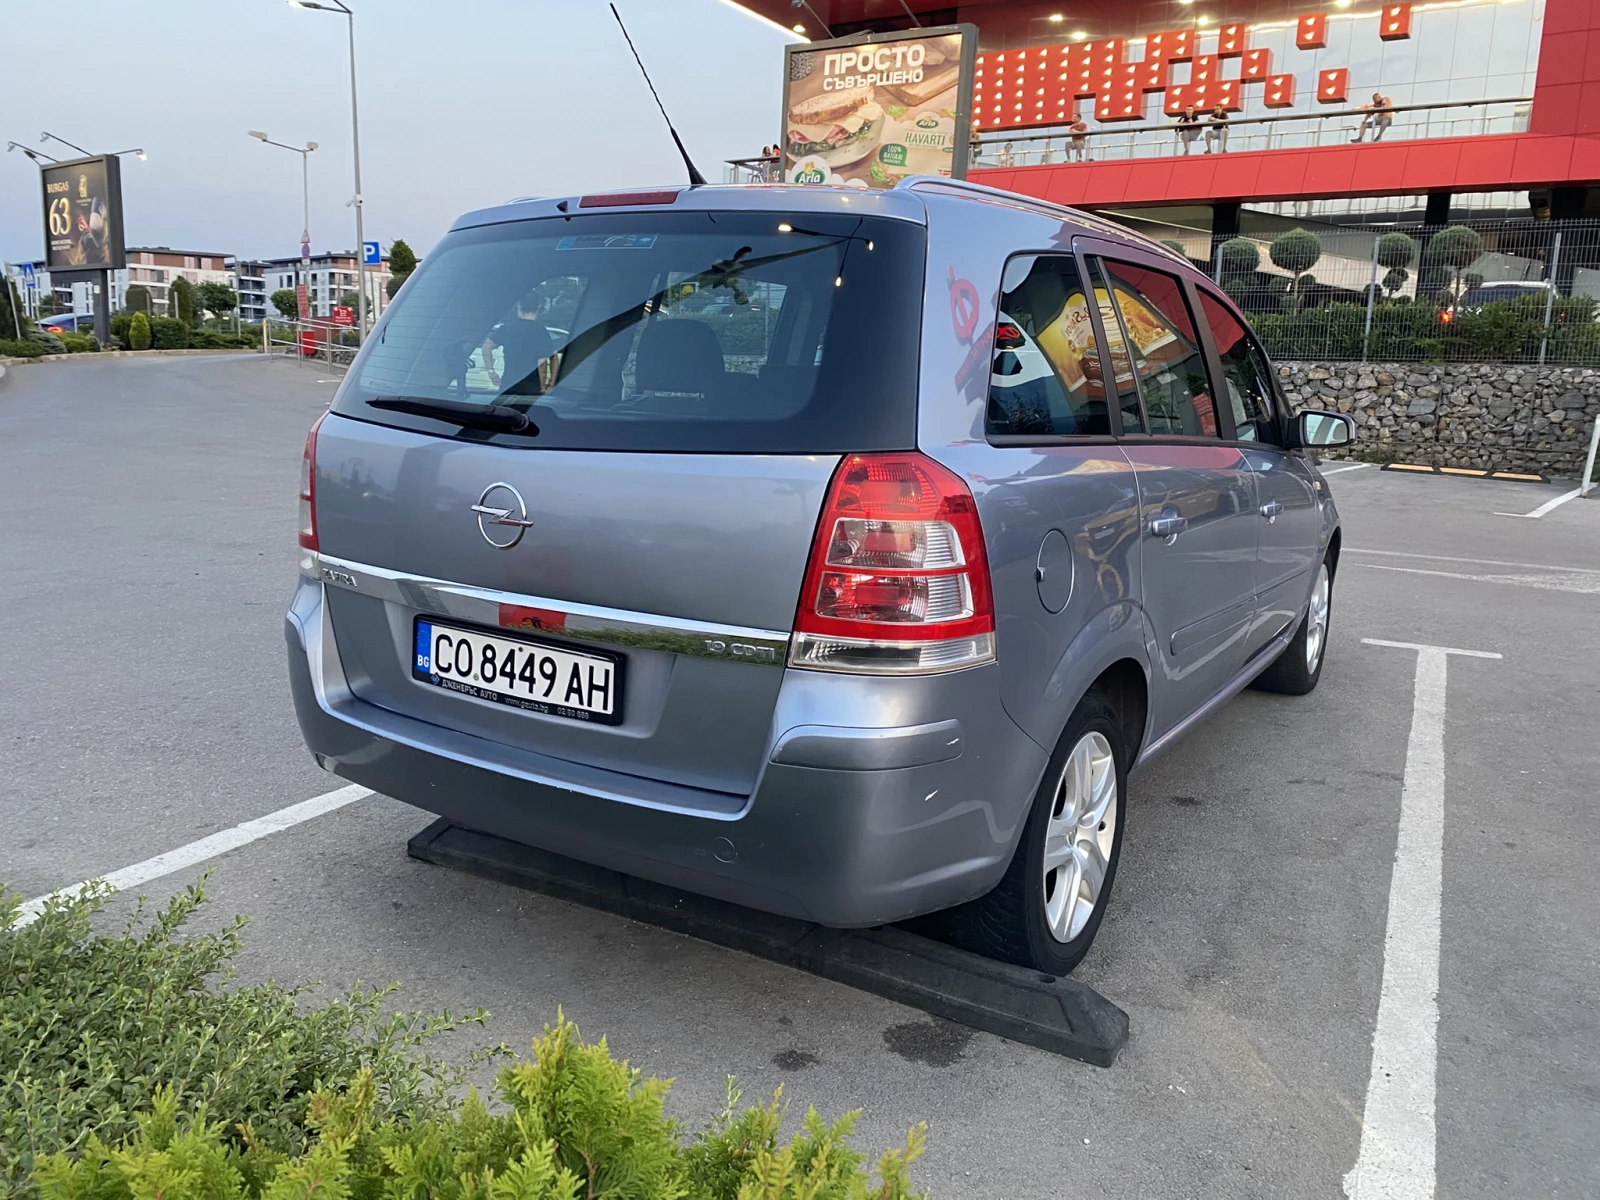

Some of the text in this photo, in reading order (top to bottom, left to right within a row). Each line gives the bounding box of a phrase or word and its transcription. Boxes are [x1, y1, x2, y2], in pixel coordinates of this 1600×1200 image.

[824, 44, 926, 76] ПРОСТО
[823, 69, 924, 91] СЪВЪРШЕНО
[905, 132, 946, 146] HAVARTI
[887, 145, 902, 153] 100%
[798, 172, 820, 183] Arla
[47, 181, 69, 193] BURGAS
[49, 197, 71, 235] 63
[363, 244, 376, 262] P
[322, 567, 358, 587] ZAFIRA
[730, 643, 775, 659] CDTI
[417, 654, 430, 668] BG
[434, 633, 611, 711] CO 8449 AH
[441, 678, 498, 701] ДЖЕНЕРЪС АУТО
